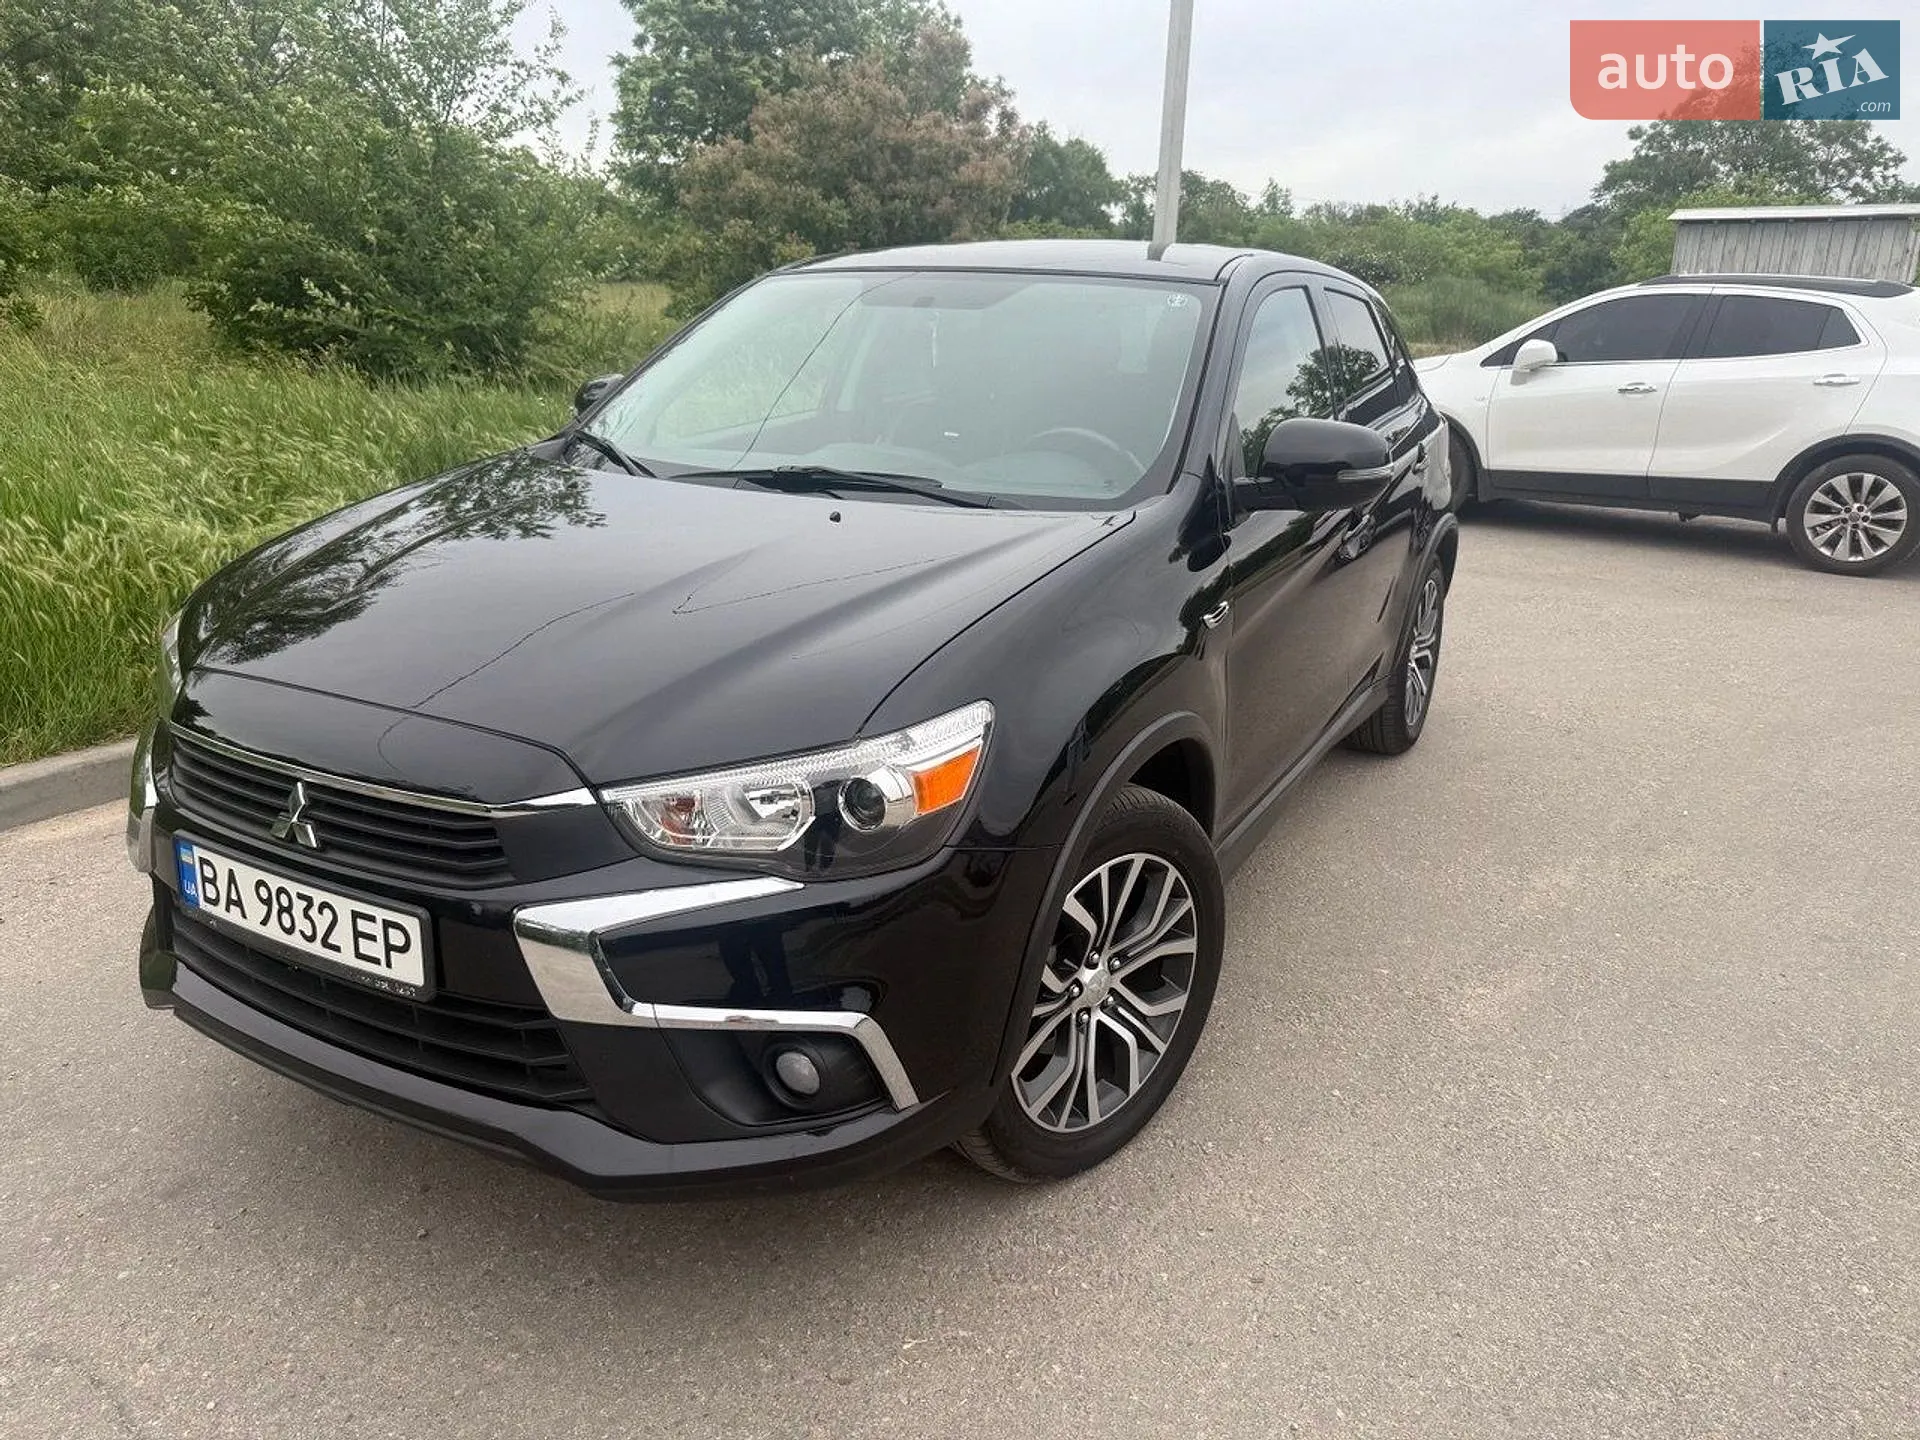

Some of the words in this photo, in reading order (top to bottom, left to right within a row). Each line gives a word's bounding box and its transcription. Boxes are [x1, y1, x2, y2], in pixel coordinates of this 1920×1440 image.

[184, 880, 198, 898] UA
[198, 856, 248, 920] BA
[254, 879, 342, 954] 9832
[350, 908, 411, 969] EP
